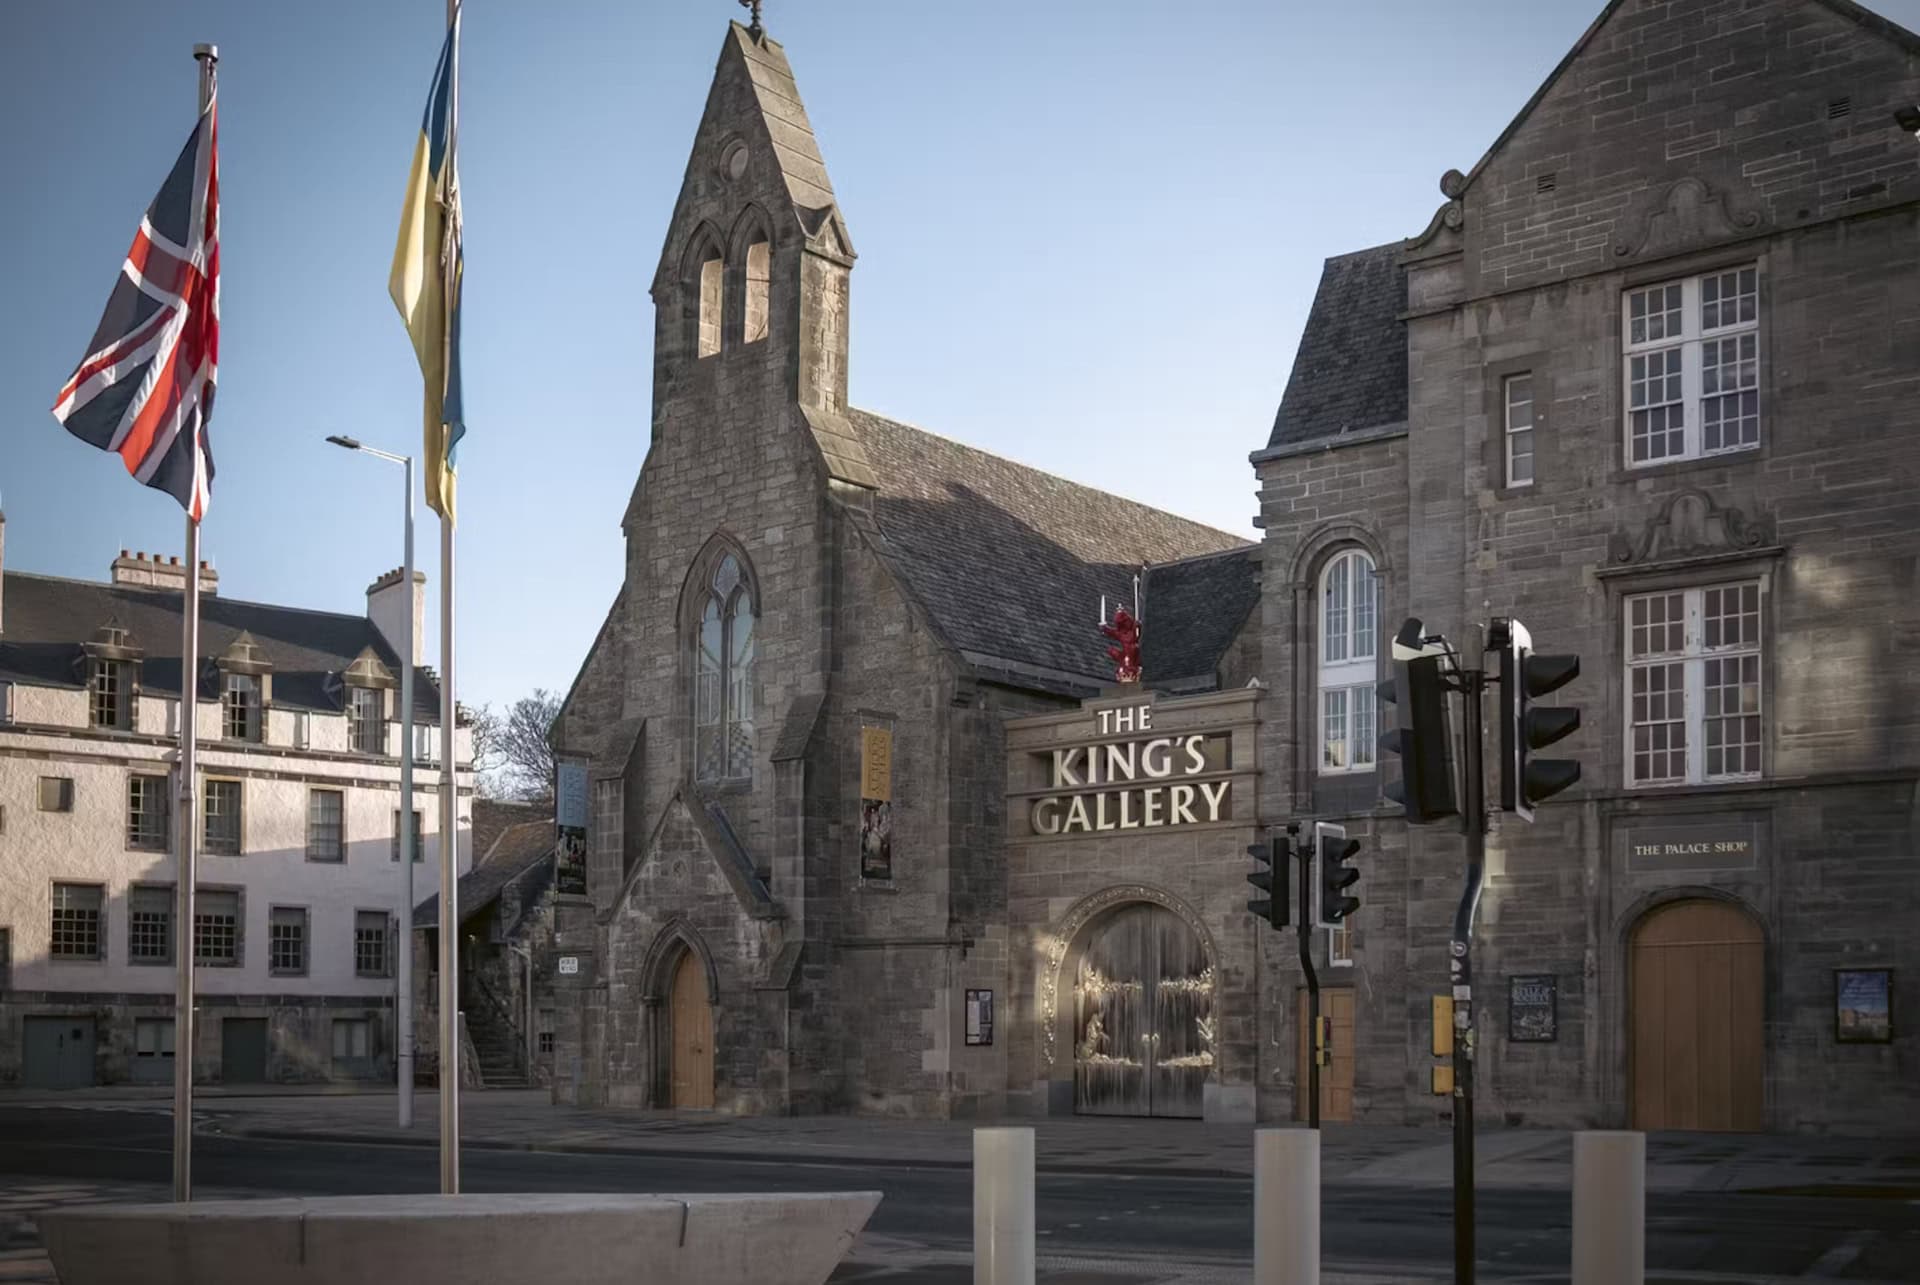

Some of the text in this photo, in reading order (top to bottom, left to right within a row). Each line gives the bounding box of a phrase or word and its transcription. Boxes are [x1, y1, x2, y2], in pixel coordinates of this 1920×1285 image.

[1098, 705, 1151, 734] THE
[1053, 735, 1205, 787] KING'S
[1031, 781, 1230, 835] GALLERY
[1634, 841, 1748, 856] THE PALACE SHOP
